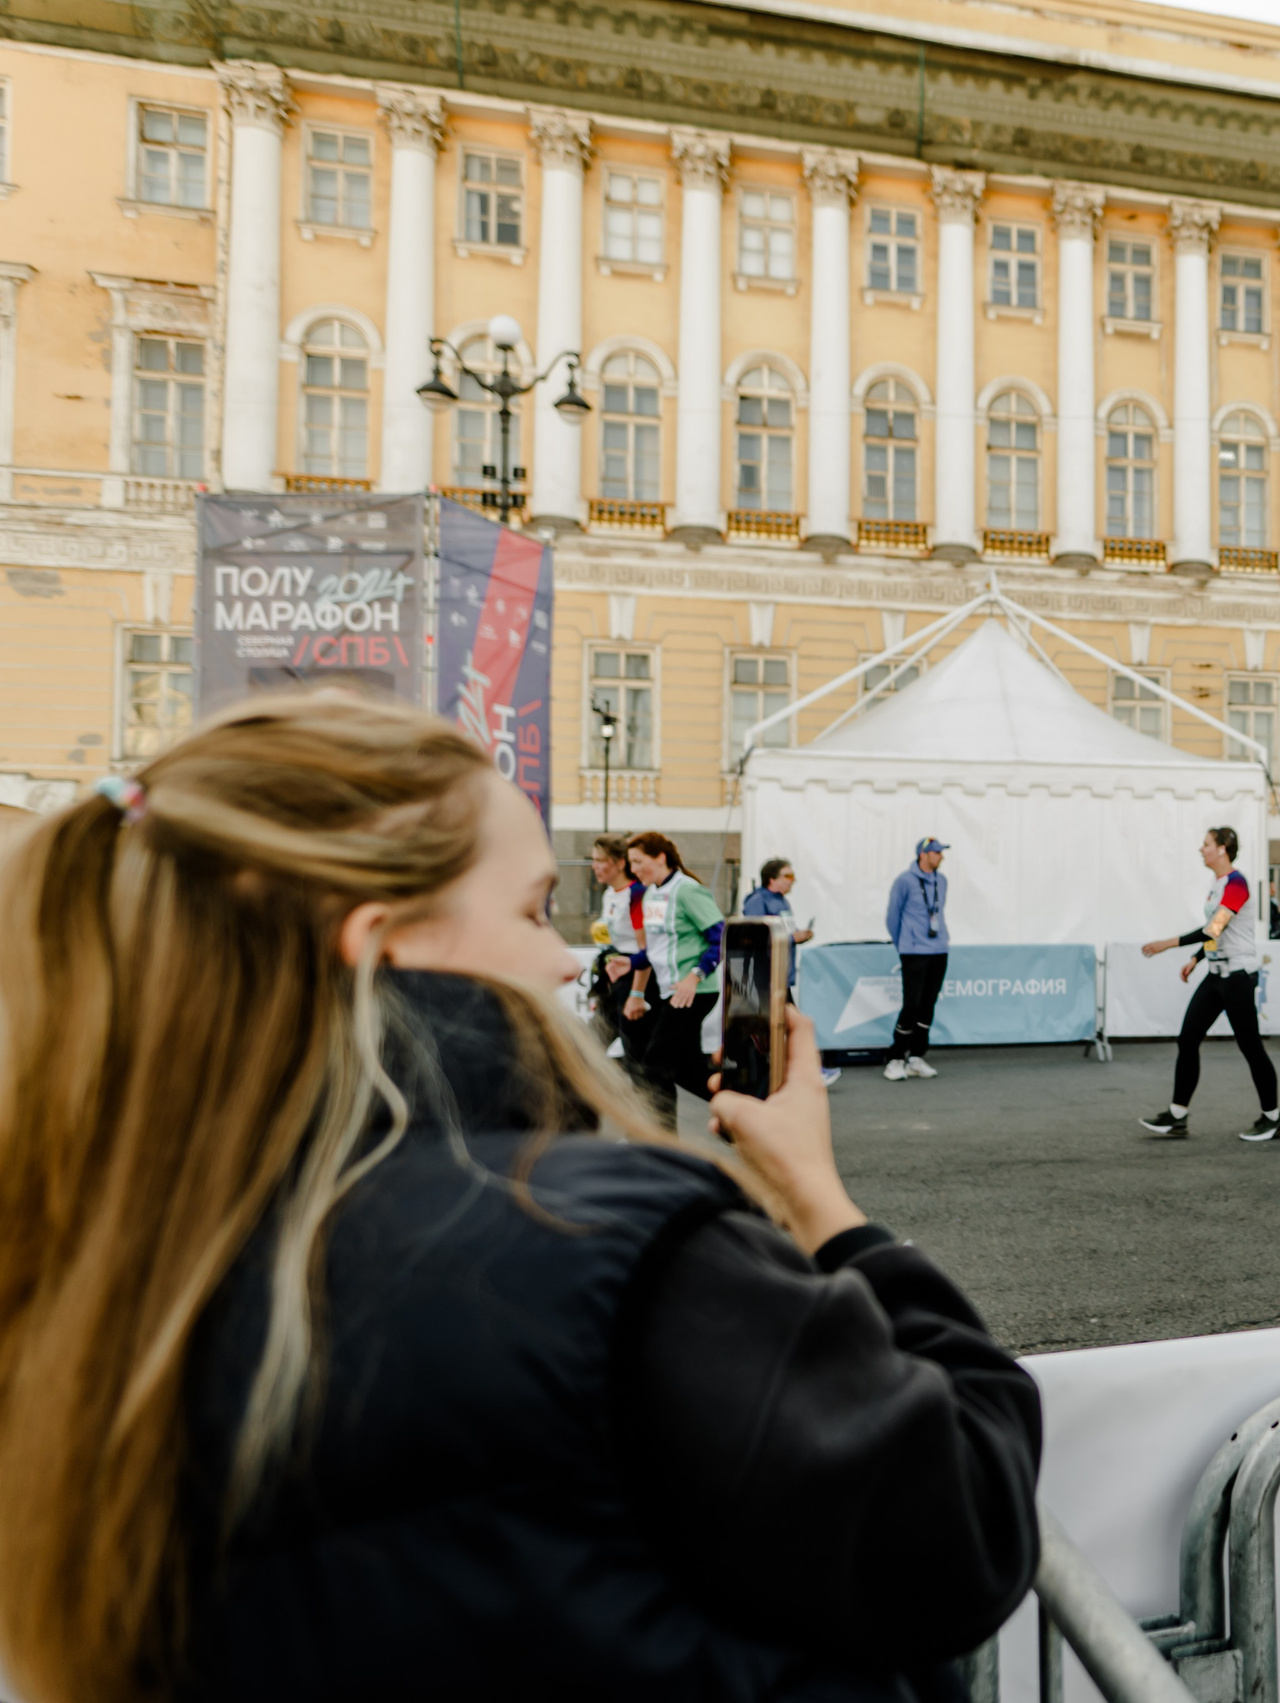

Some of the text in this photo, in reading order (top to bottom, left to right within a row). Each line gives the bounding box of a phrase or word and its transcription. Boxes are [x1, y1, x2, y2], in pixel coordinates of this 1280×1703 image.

[214, 566, 415, 604] ПОЛУ 2024
[213, 600, 400, 632] МАРАФОН
[938, 978, 1067, 1000] ЕМОГРАФИЯ
